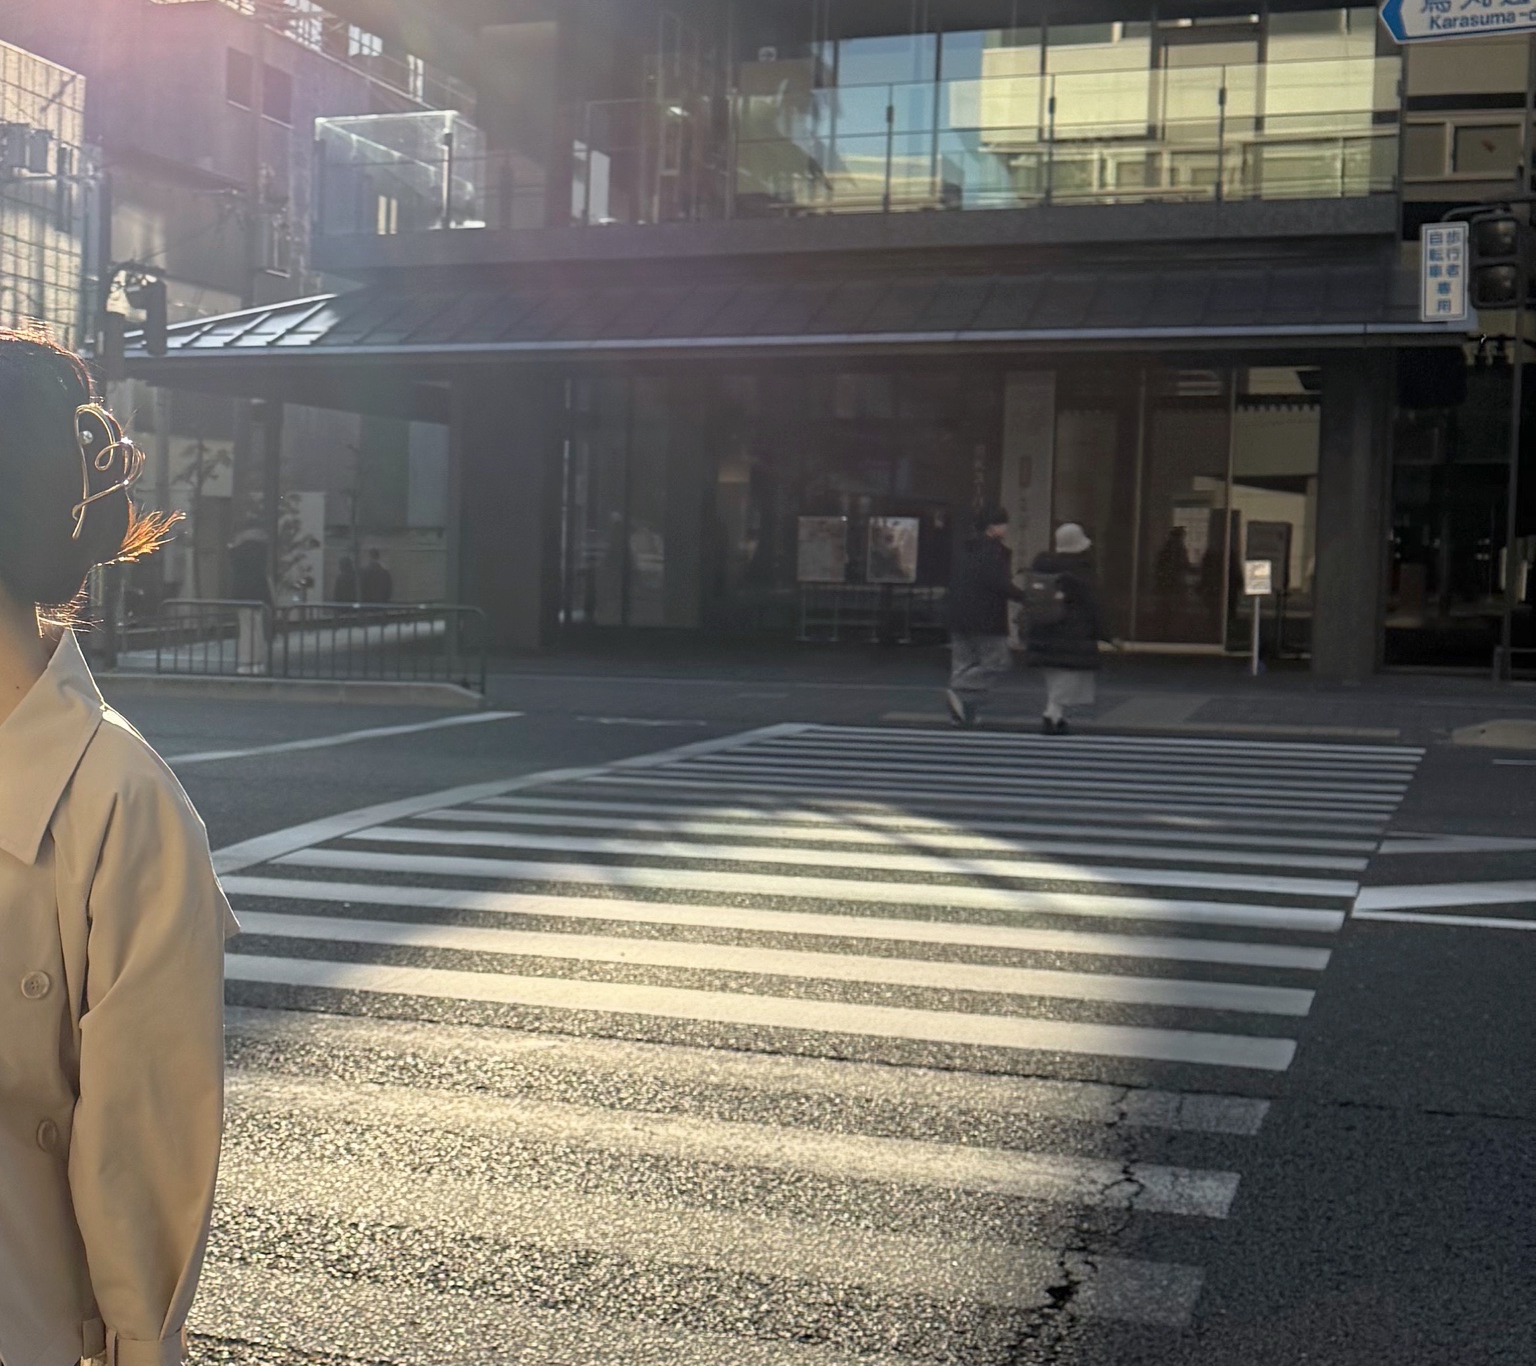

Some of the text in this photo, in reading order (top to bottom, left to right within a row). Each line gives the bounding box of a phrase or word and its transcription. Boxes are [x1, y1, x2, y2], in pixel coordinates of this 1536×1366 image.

[1429, 232, 1443, 277] 自転車
[1446, 230, 1460, 277] 歩行者
